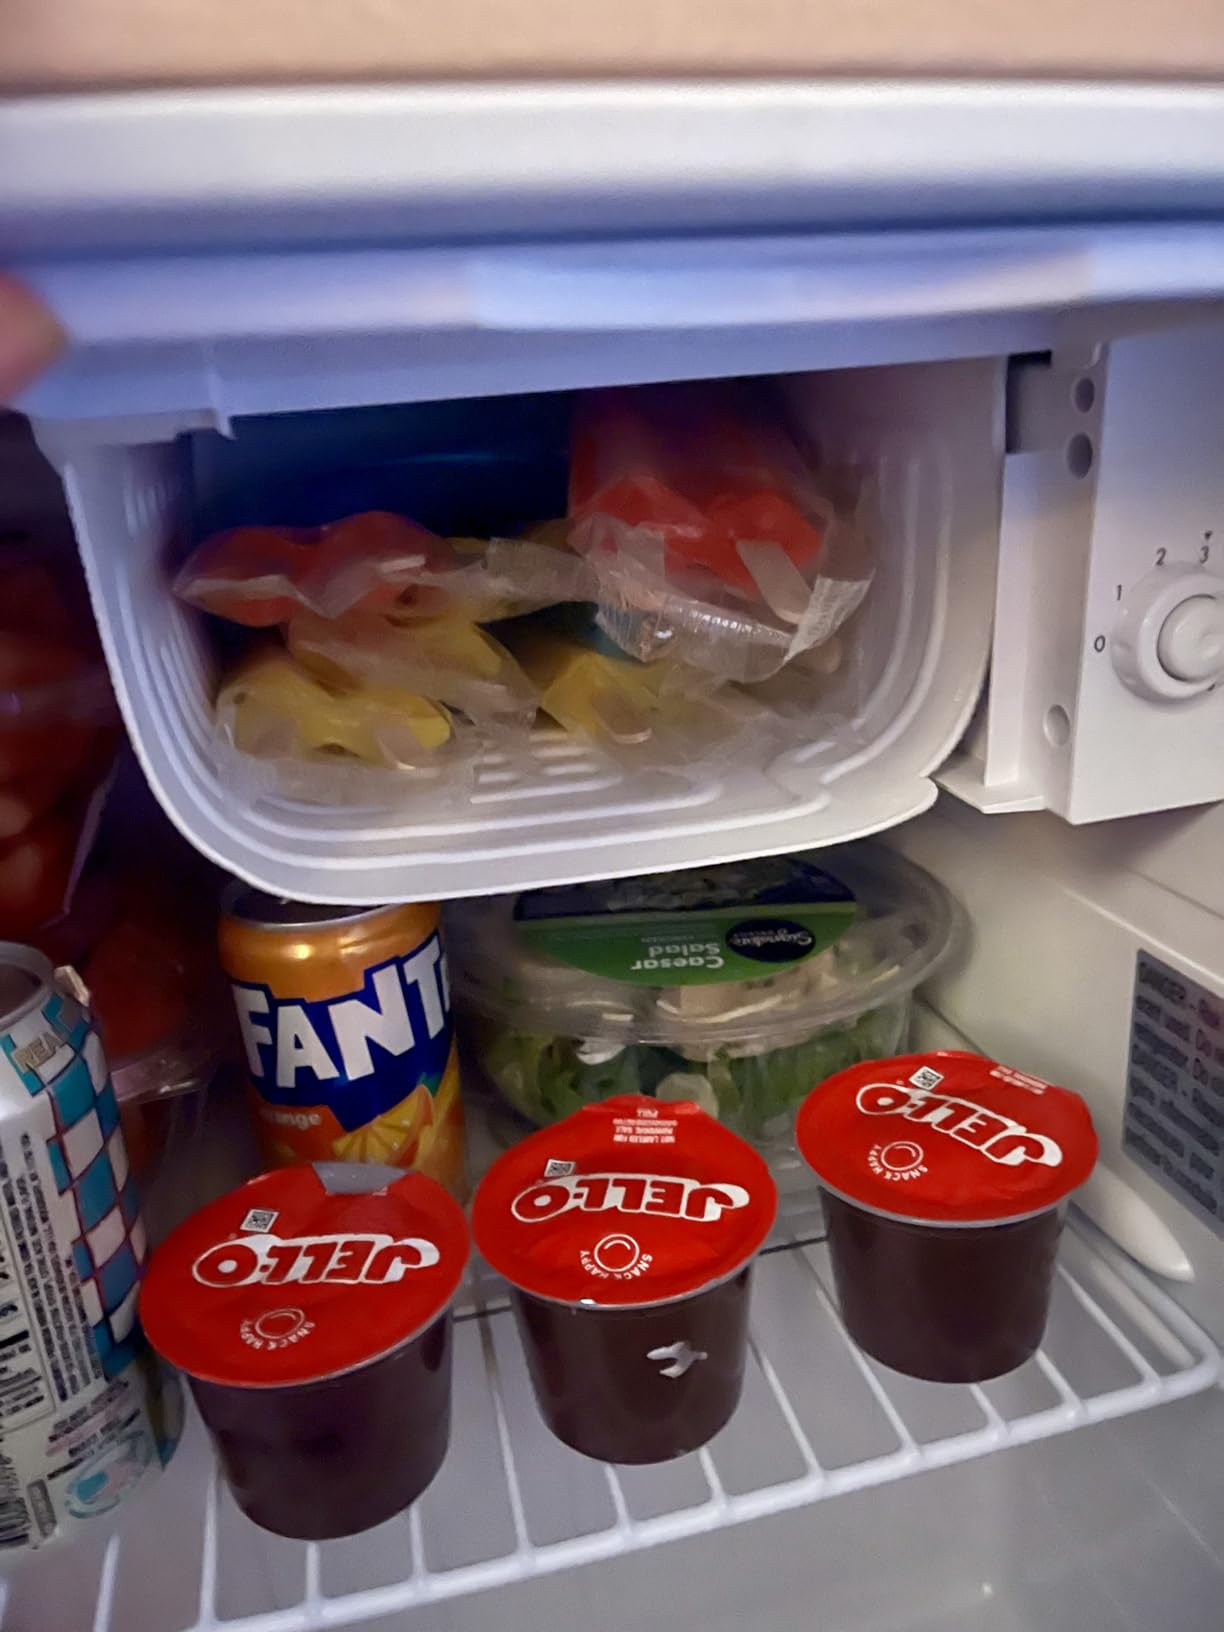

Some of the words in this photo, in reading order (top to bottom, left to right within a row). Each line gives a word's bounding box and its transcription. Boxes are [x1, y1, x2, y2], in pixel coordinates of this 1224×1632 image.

[1155, 547, 1167, 566] 2
[1199, 545, 1210, 564] 3
[1115, 584, 1122, 601] 1
[648, 942, 721, 958] Salad
[630, 956, 725, 971] Caesar
[856, 1083, 1063, 1167] JELL-O
[884, 1164, 928, 1182] SNACK
[511, 1172, 750, 1223] JELL-O
[192, 1233, 440, 1288] JELL-O
[580, 1249, 610, 1280] HAPPY
[614, 1254, 653, 1280] SNACK
